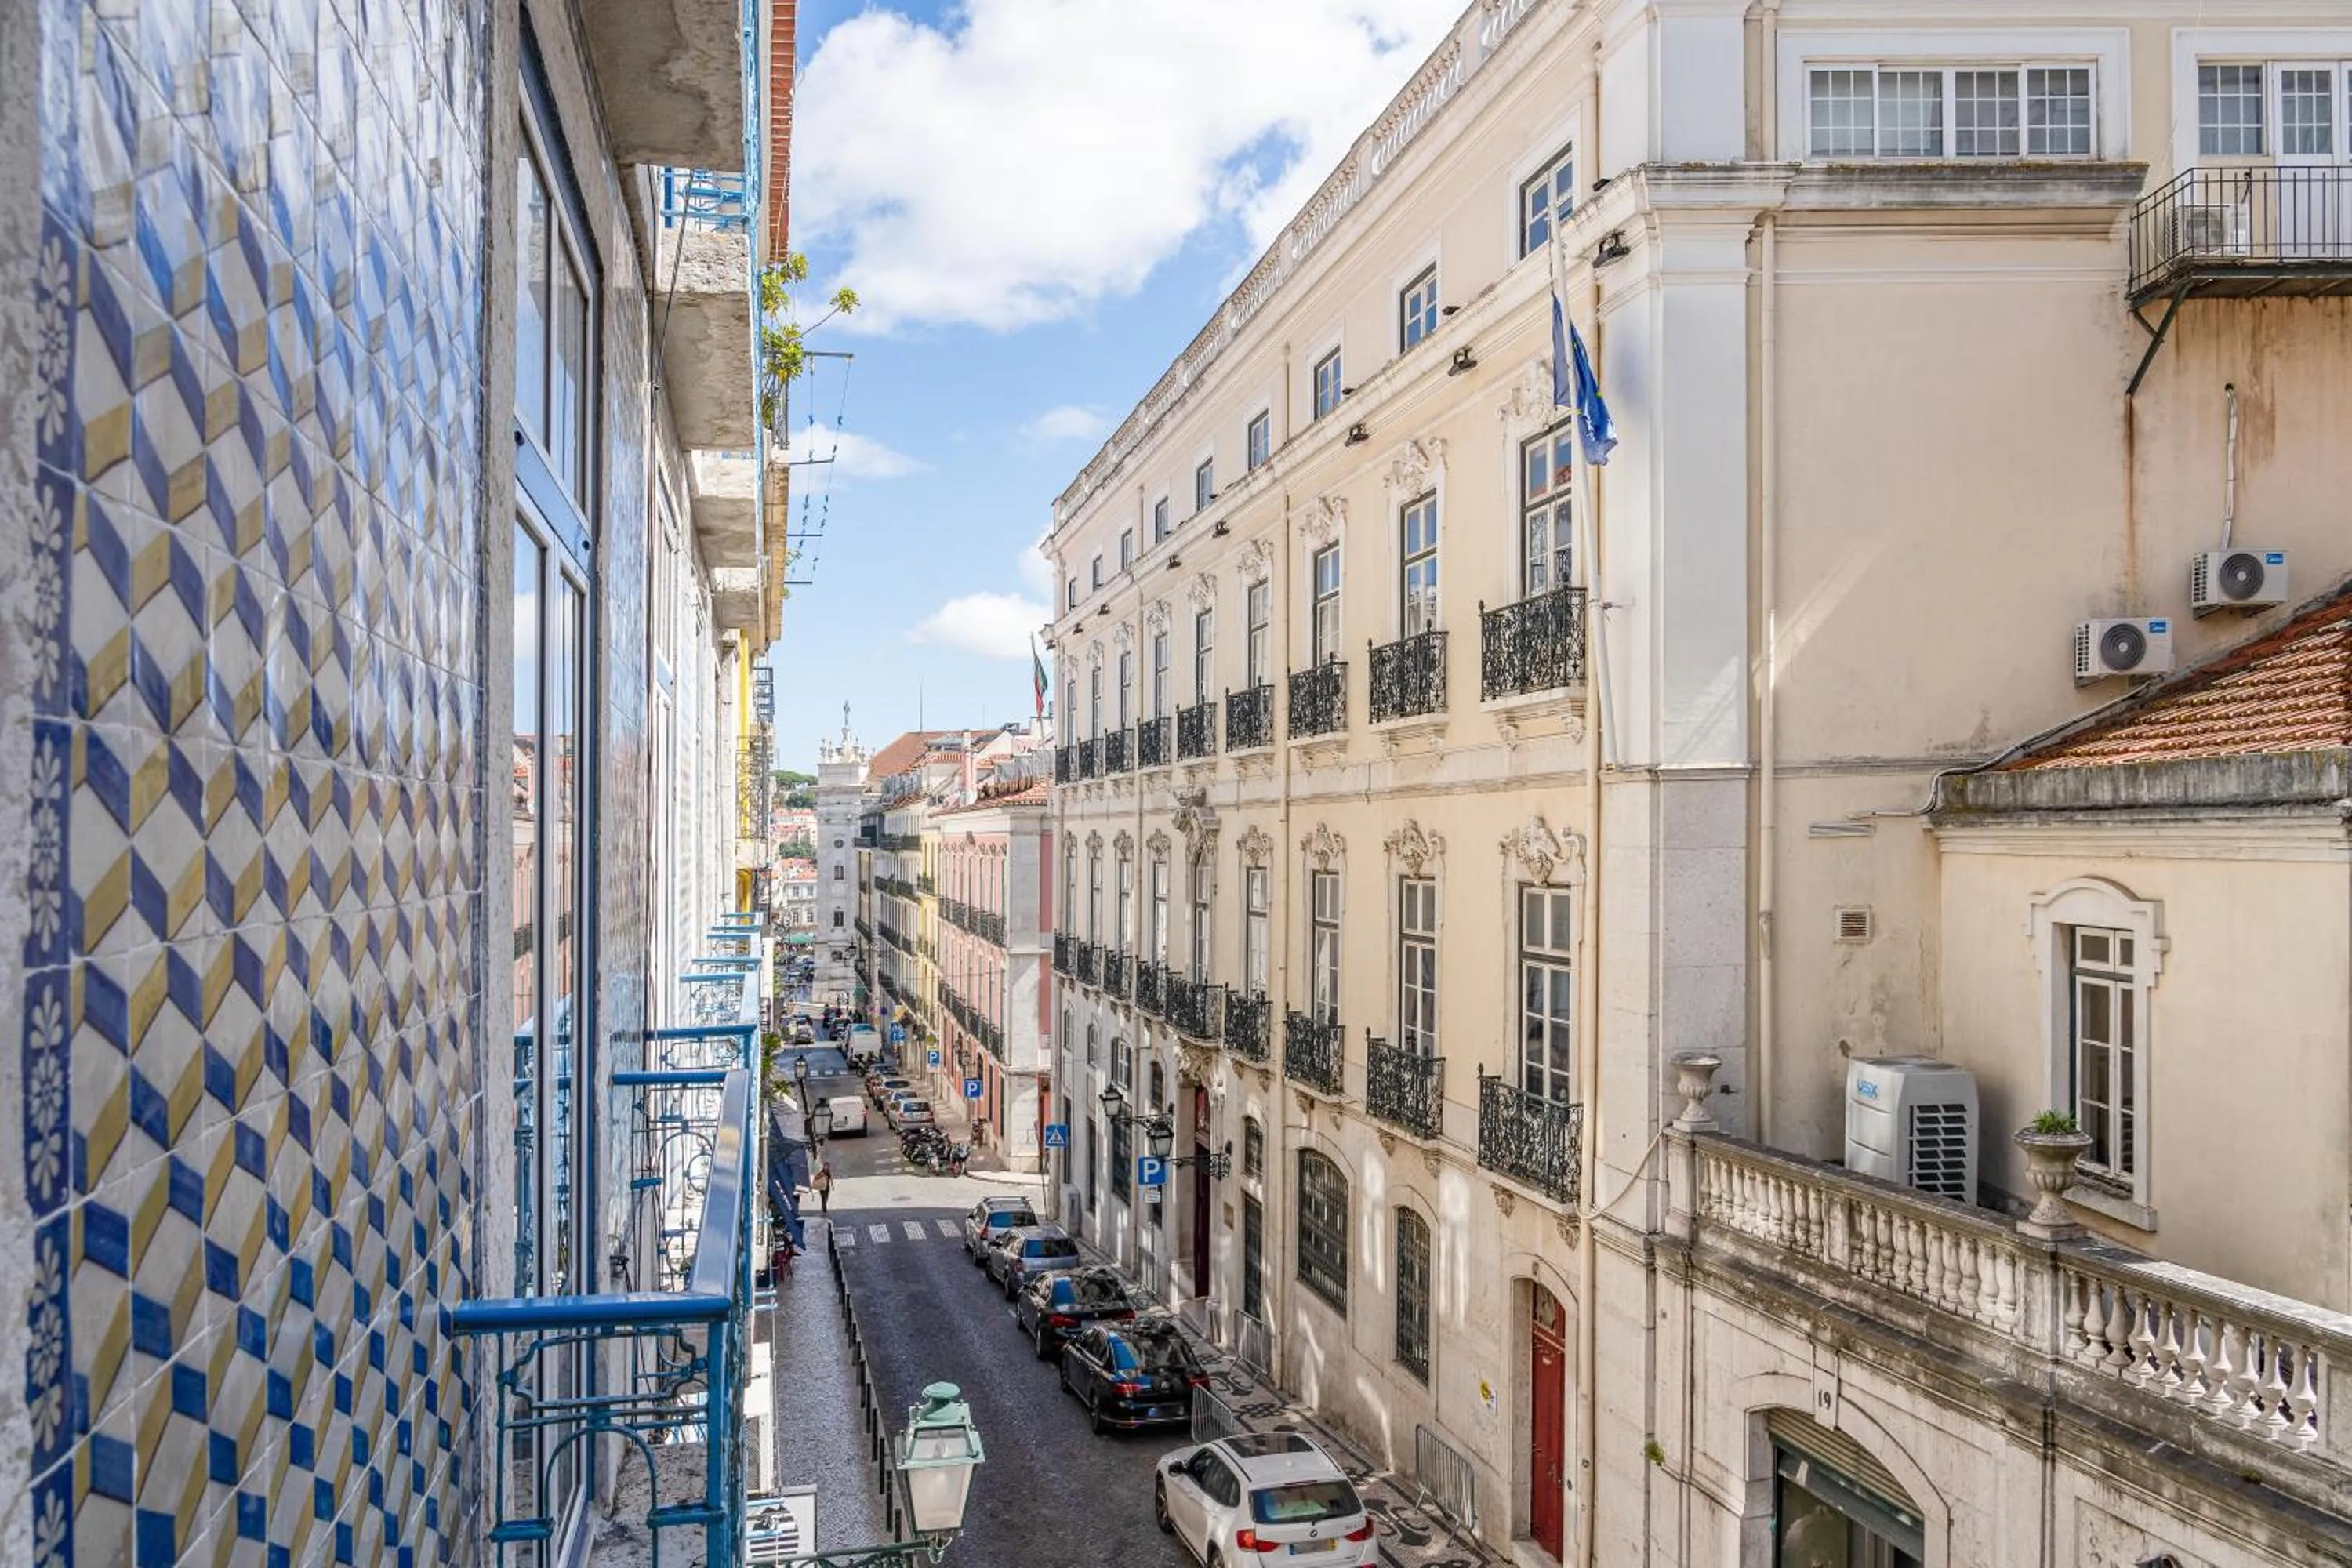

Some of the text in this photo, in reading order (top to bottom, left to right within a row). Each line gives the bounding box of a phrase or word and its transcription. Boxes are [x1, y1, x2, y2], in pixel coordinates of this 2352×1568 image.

[967, 1083, 978, 1096] P
[1144, 1159, 1160, 1182] P
[1818, 1389, 1831, 1410] 19
